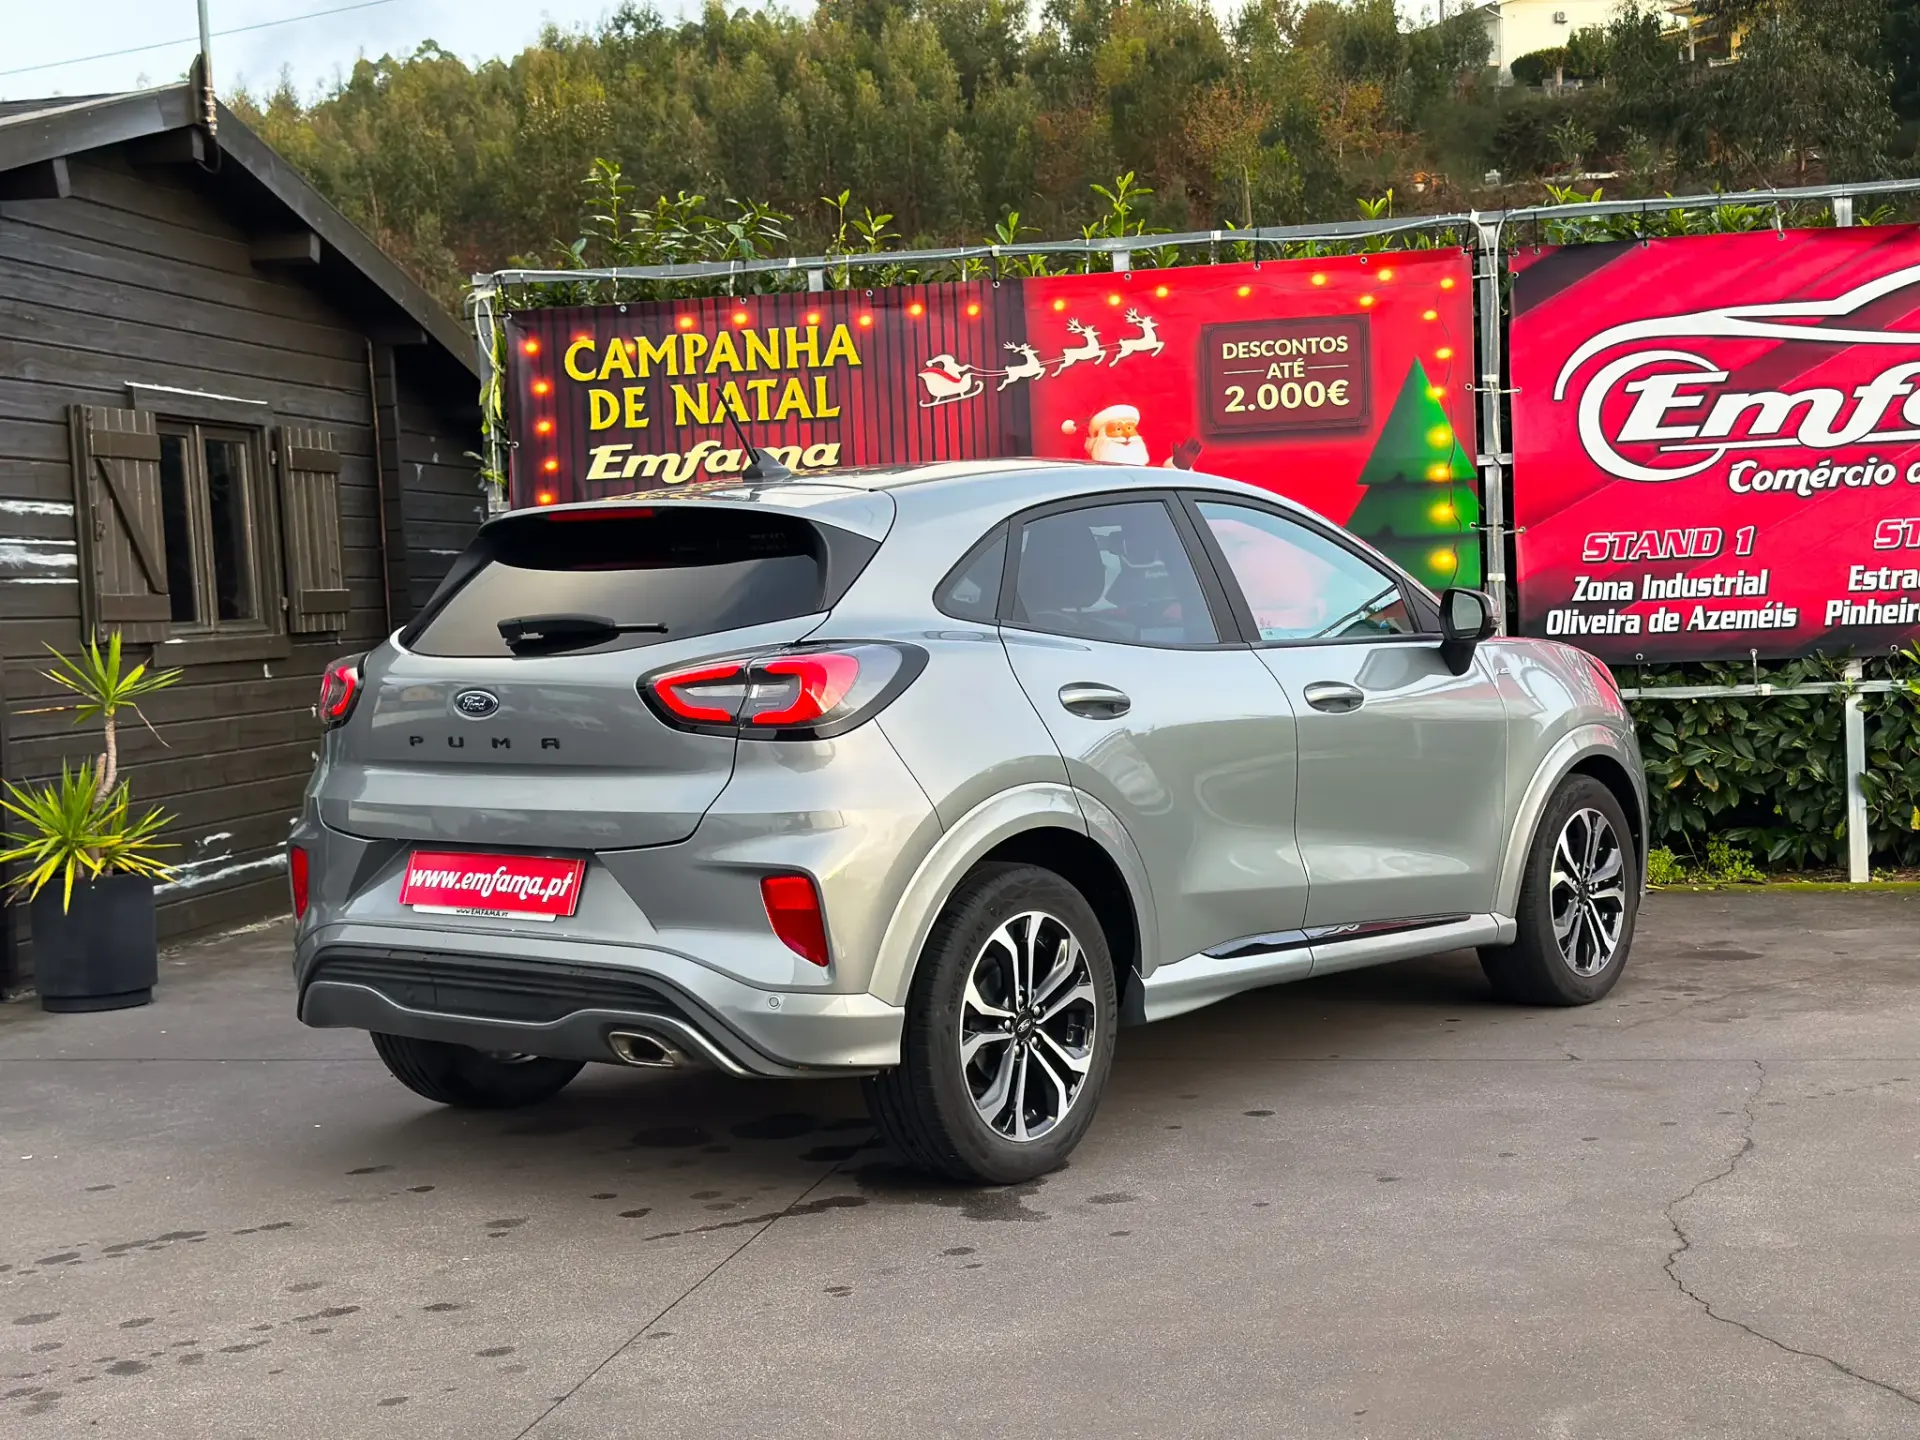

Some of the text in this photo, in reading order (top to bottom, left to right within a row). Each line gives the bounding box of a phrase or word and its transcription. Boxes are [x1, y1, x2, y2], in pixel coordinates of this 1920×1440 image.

[564, 323, 862, 382] CAMPANHA
[1222, 335, 1348, 360] DESCONTOS
[1266, 358, 1305, 379] ATÉ
[589, 375, 841, 431] DE NATAL
[1224, 379, 1350, 412] 2.000€
[1729, 457, 1897, 496] Comércio
[1582, 525, 1755, 562] STAND 1
[1572, 569, 1768, 602] Zona Industrial
[1848, 564, 1920, 592] Estra
[1546, 602, 1797, 636] Oliveira de Azeméis
[1824, 597, 1920, 627] Pinheir
[462, 695, 487, 710] Ford
[409, 735, 561, 750] PUMA
[409, 866, 574, 903] www.emfama.pt
